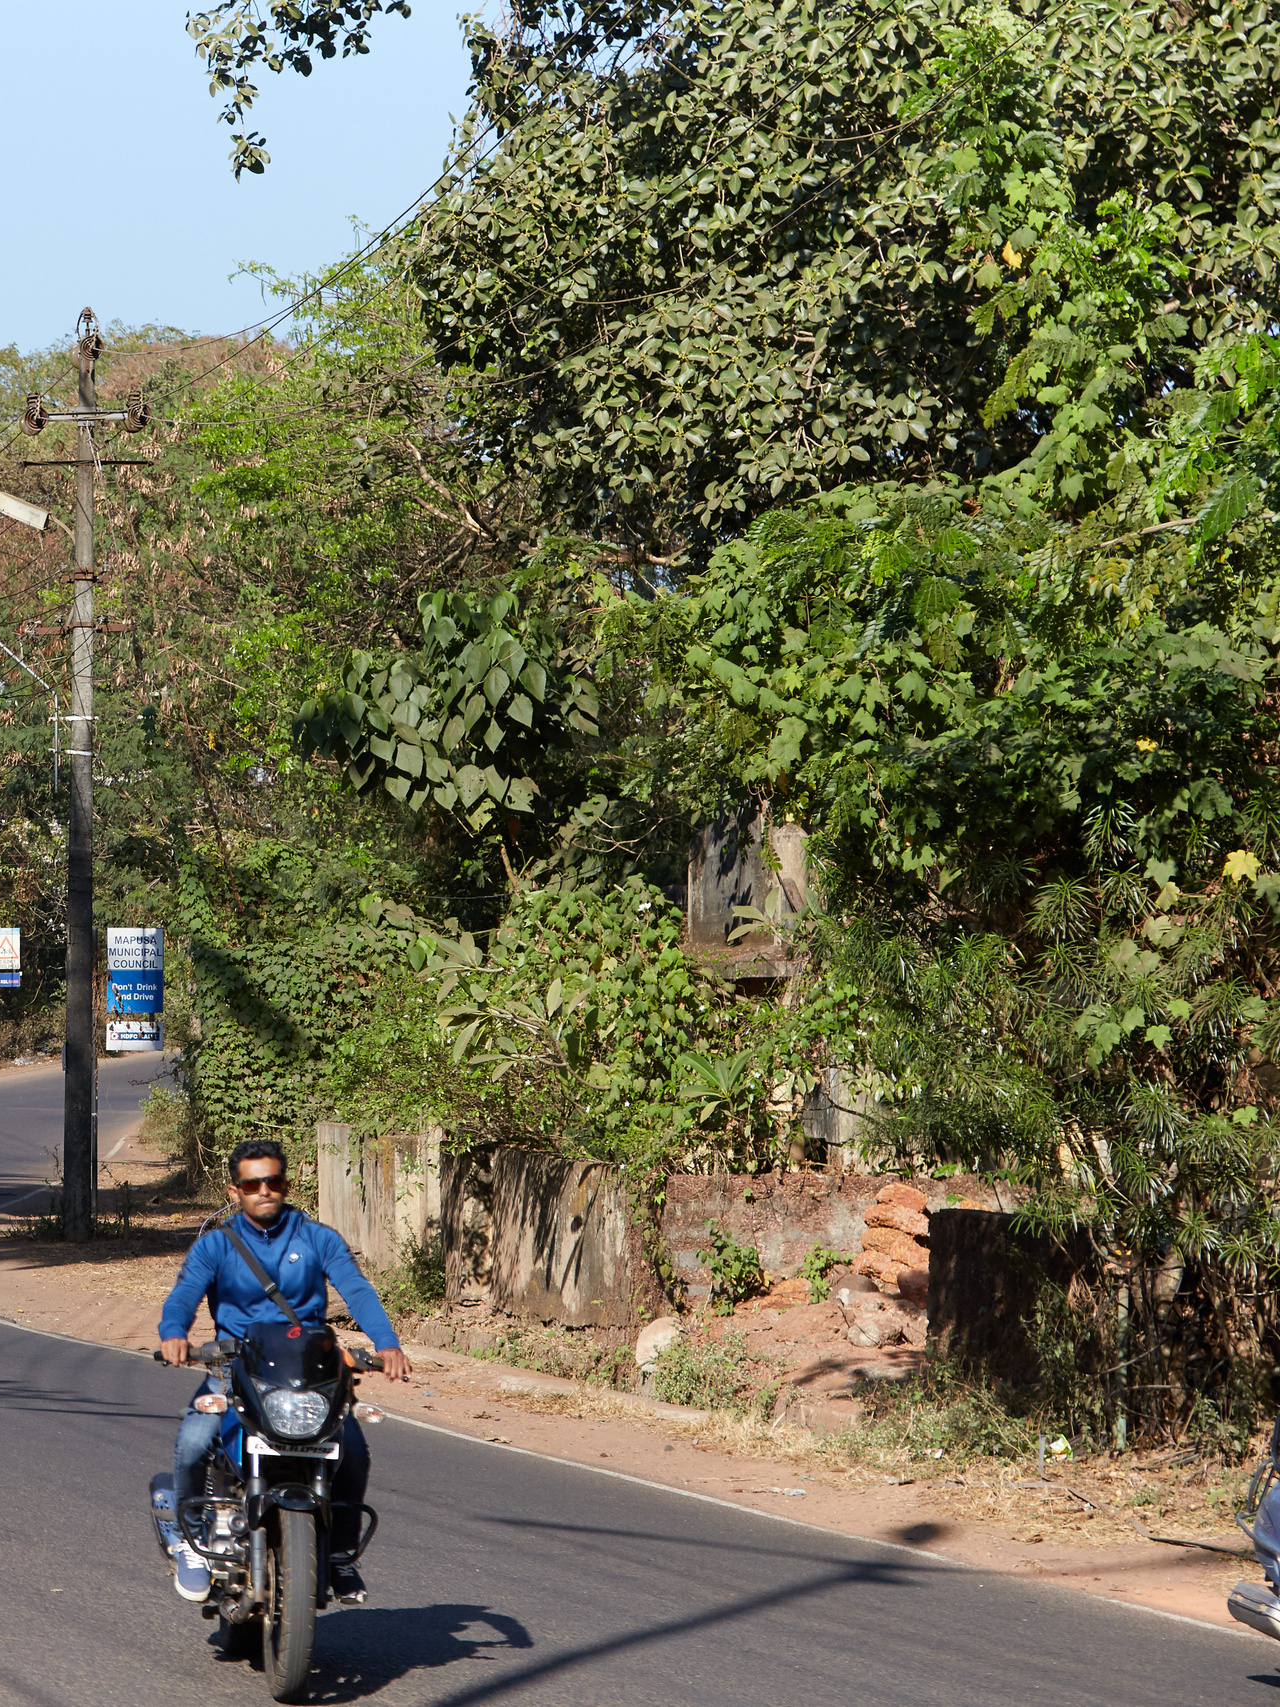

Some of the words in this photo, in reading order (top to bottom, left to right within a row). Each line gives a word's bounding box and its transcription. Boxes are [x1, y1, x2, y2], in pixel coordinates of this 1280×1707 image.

[114, 936, 157, 945] MAPUSA
[108, 947, 162, 957] MUNICIPAL
[113, 959, 158, 969] COUNCIL
[136, 982, 158, 991] Drink
[133, 993, 155, 1001] Drive
